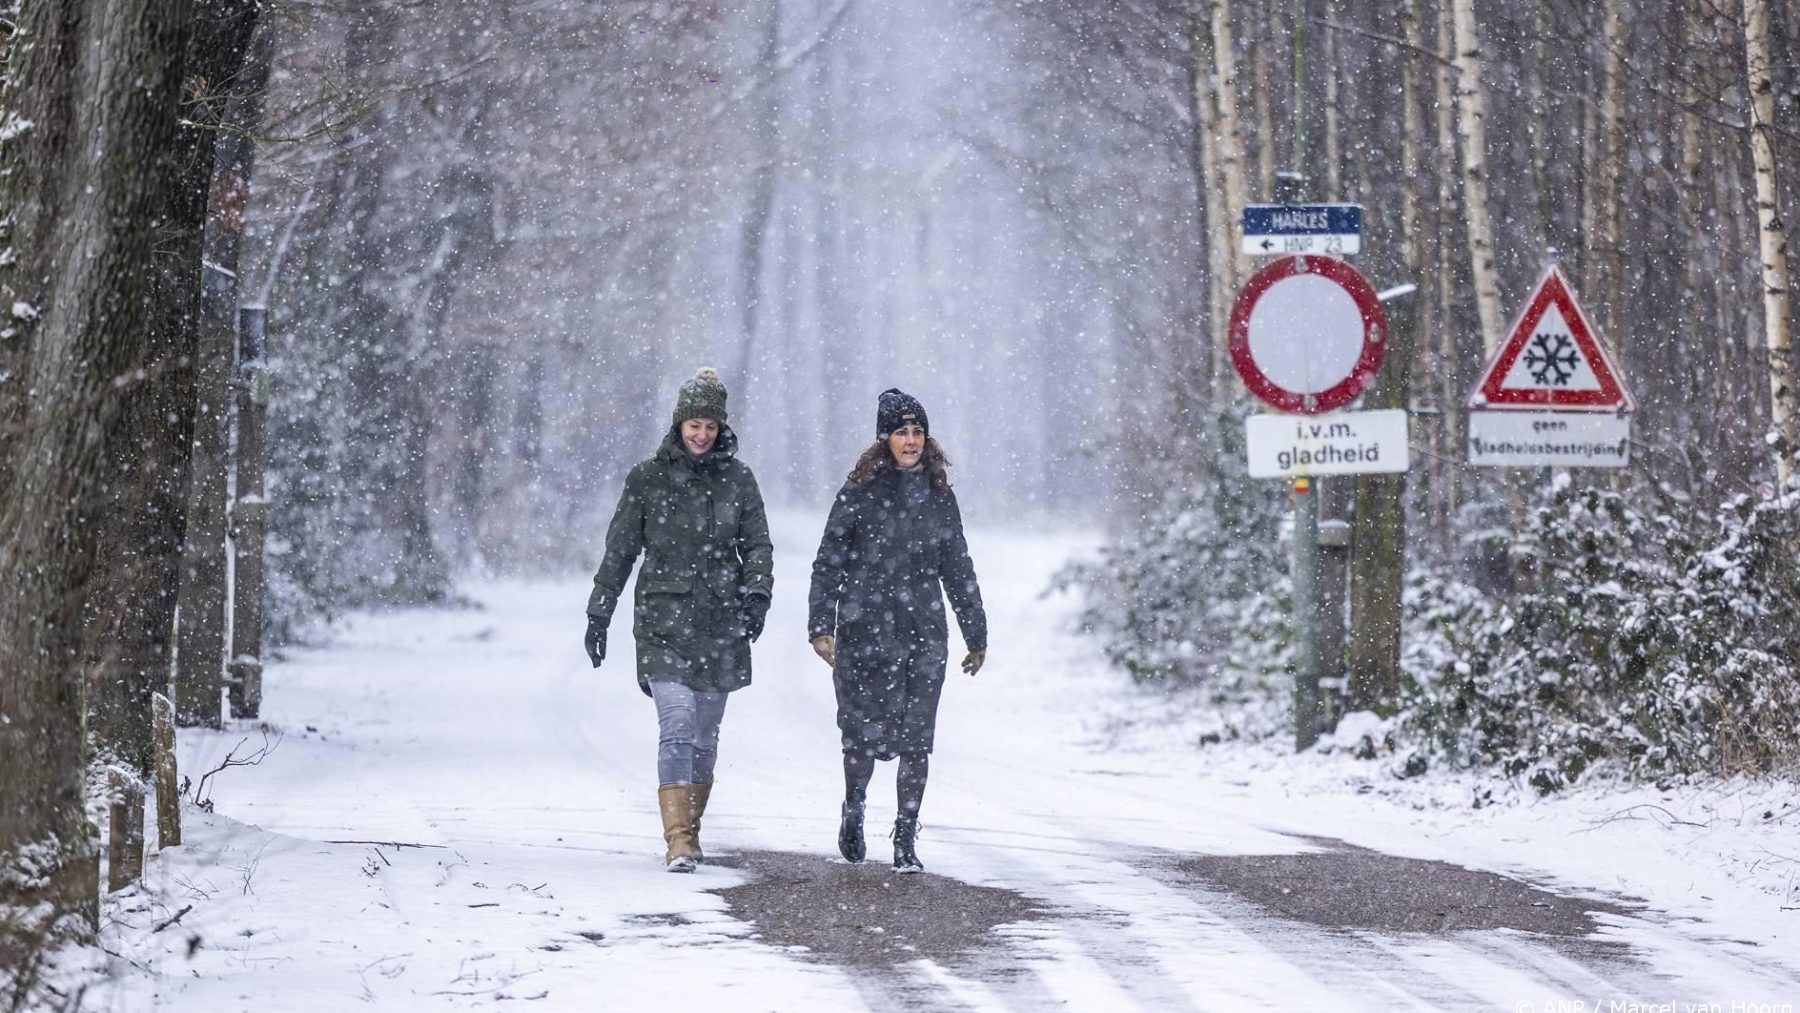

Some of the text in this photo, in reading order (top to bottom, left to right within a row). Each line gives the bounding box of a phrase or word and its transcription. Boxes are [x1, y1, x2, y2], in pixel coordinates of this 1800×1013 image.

[1324, 236, 1342, 254] 23
[1297, 422, 1356, 439] i.v.m.
[1532, 420, 1568, 433] geen
[1277, 442, 1379, 470] gladheid
